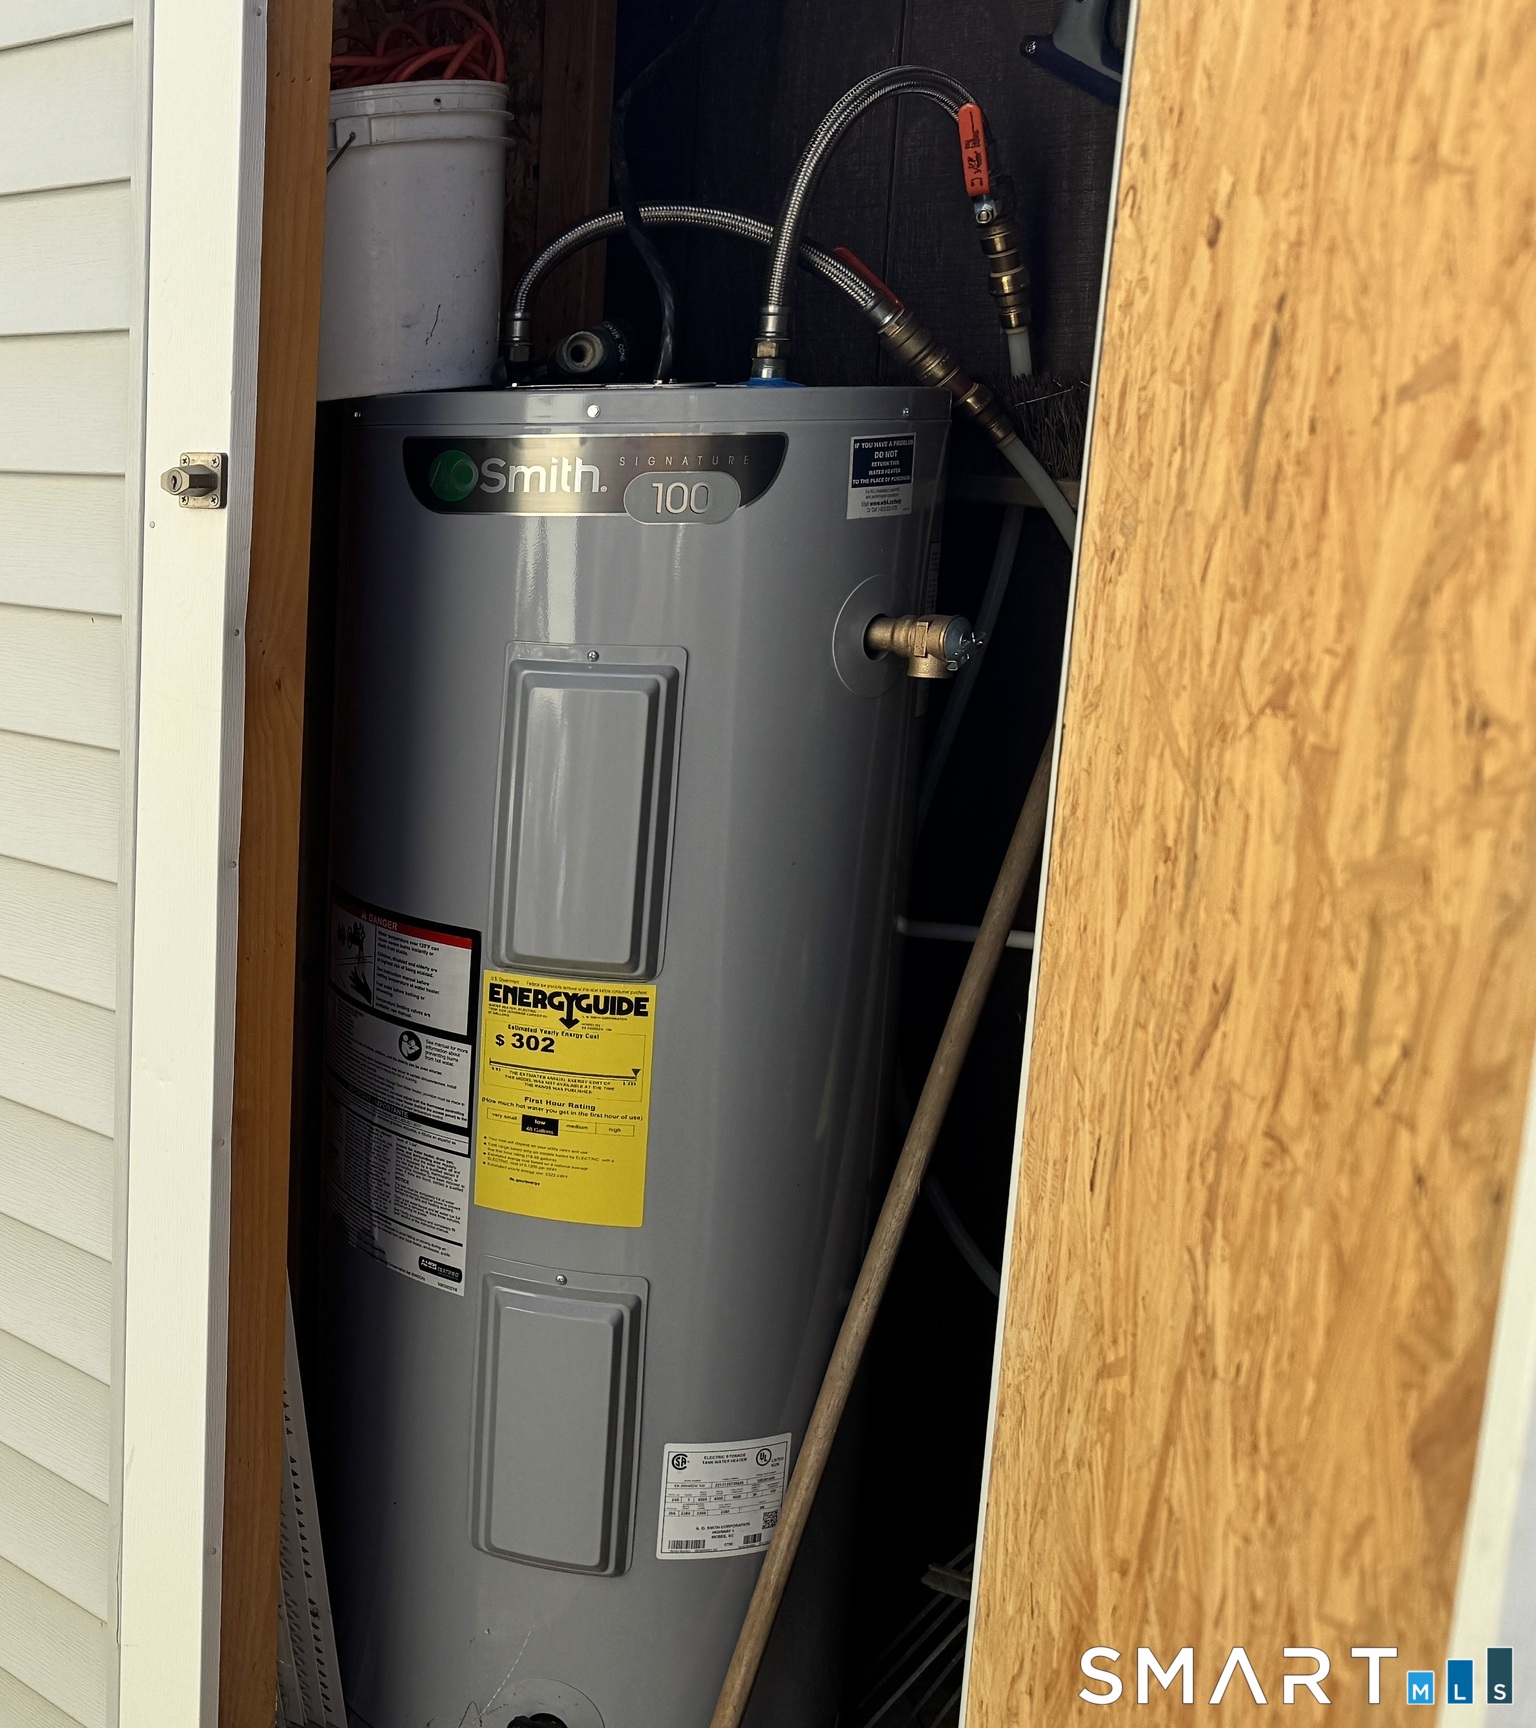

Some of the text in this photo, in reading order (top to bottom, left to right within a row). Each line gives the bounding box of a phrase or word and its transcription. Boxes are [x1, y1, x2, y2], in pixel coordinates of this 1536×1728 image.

[874, 450, 898, 459] DO NOT
[619, 455, 750, 467] SIGNATURE
[651, 481, 710, 514] 100
[369, 913, 398, 931] DANGER
[411, 946, 429, 956] instantly
[405, 966, 416, 974] being
[416, 964, 430, 972] elderly
[405, 991, 420, 1000] bathing
[507, 1024, 537, 1033] Estimated
[539, 1029, 559, 1037] Yearly
[561, 1031, 583, 1039] Energy
[495, 1032, 555, 1054] $ 302
[425, 1045, 448, 1055] information
[425, 1050, 459, 1063] preventing burns
[519, 1071, 546, 1080] ESTIMATED
[524, 1096, 543, 1104] First
[568, 1102, 596, 1112] Rating
[533, 1127, 554, 1135] Gallons
[720, 1522, 750, 1530] CORPORATION
